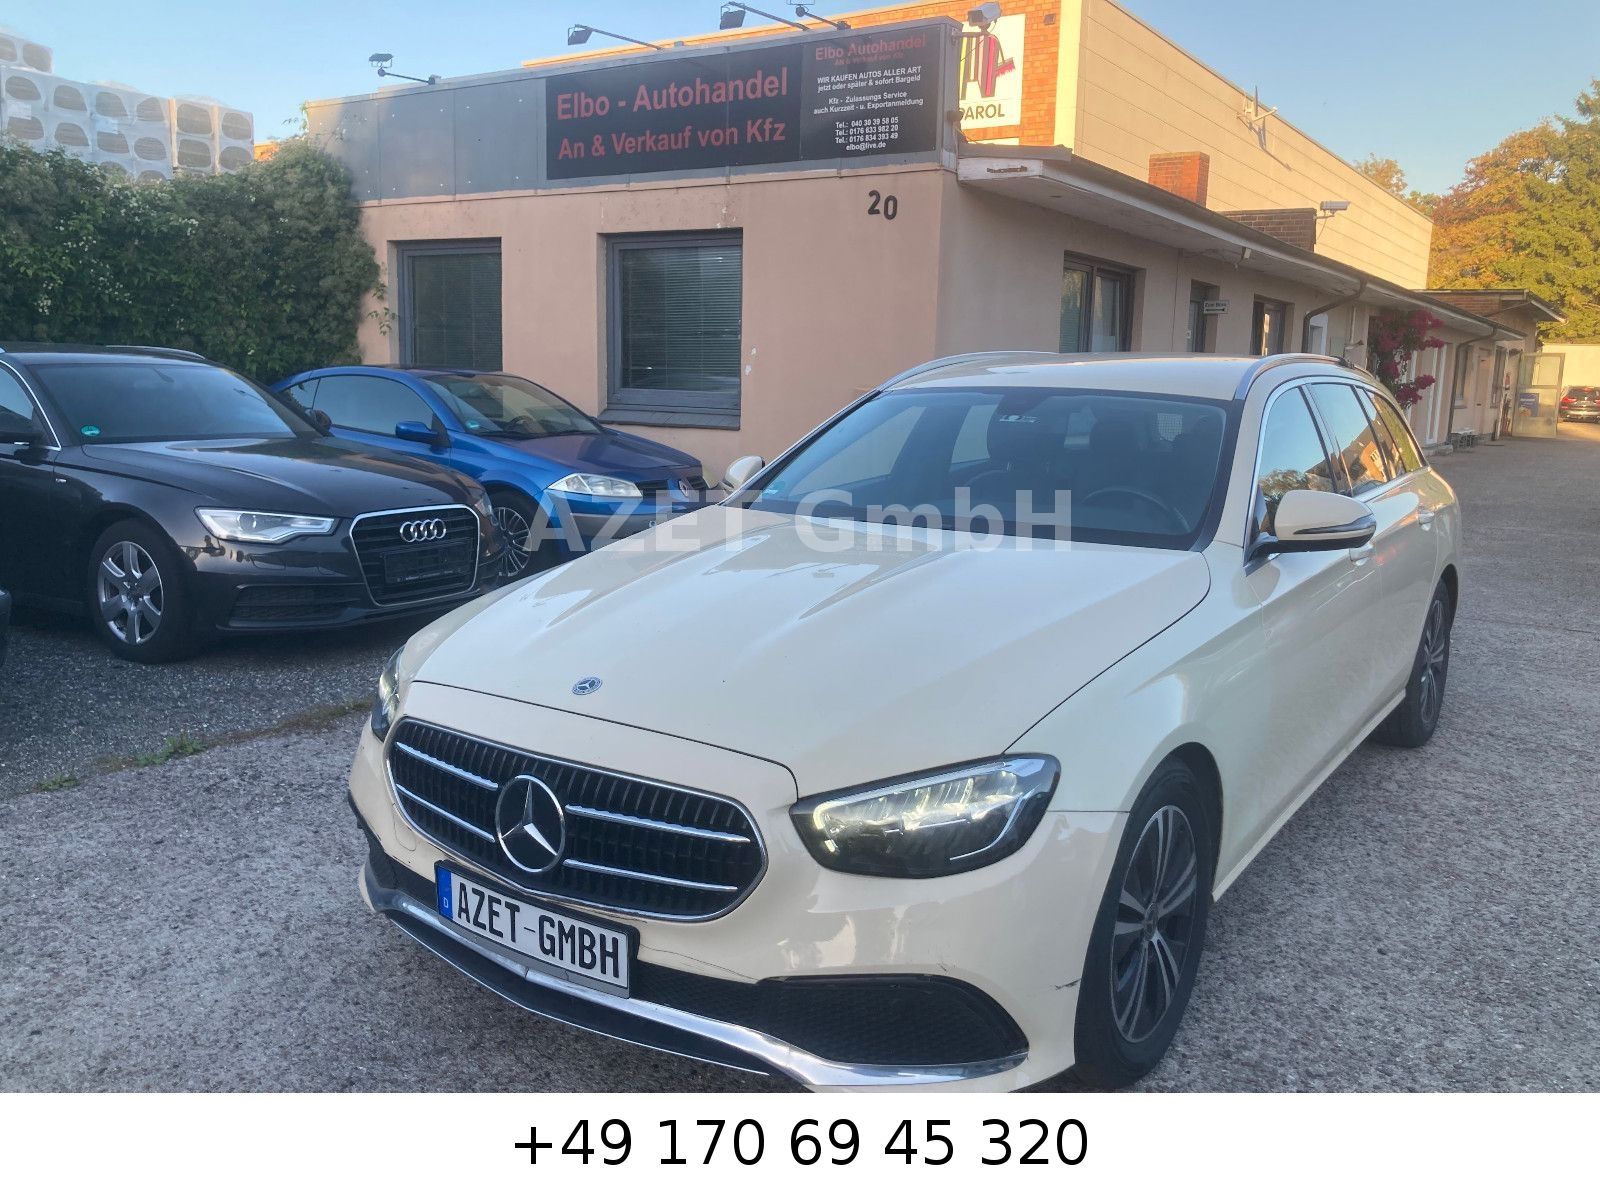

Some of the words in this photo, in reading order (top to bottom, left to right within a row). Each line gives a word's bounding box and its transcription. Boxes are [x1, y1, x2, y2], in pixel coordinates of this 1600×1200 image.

[816, 46, 844, 60] Elbo
[848, 34, 926, 56] Autohandel
[818, 83, 831, 93] jetzt
[875, 77, 894, 86] sofort
[896, 74, 920, 84] Bargeld
[831, 73, 858, 83] KAUFEN
[858, 70, 882, 80] AUTOS
[884, 68, 906, 77] ALLER
[907, 66, 922, 74] ART
[557, 92, 610, 120] Elbo
[632, 67, 788, 112] Autohandel
[846, 94, 882, 104] Zulassungs
[883, 92, 908, 100] Service
[814, 106, 828, 114] auch
[868, 98, 924, 110] Exportanmeldung
[852, 120, 862, 128] 040
[558, 138, 584, 160] An
[592, 134, 605, 157] &
[612, 126, 692, 155] Verkauf
[698, 127, 738, 147] von
[746, 118, 786, 144] Kfz
[846, 141, 886, 151] elbo@live.de
[868, 190, 898, 220] 20
[444, 897, 448, 908] D
[457, 881, 620, 978] AZET-GMBH
